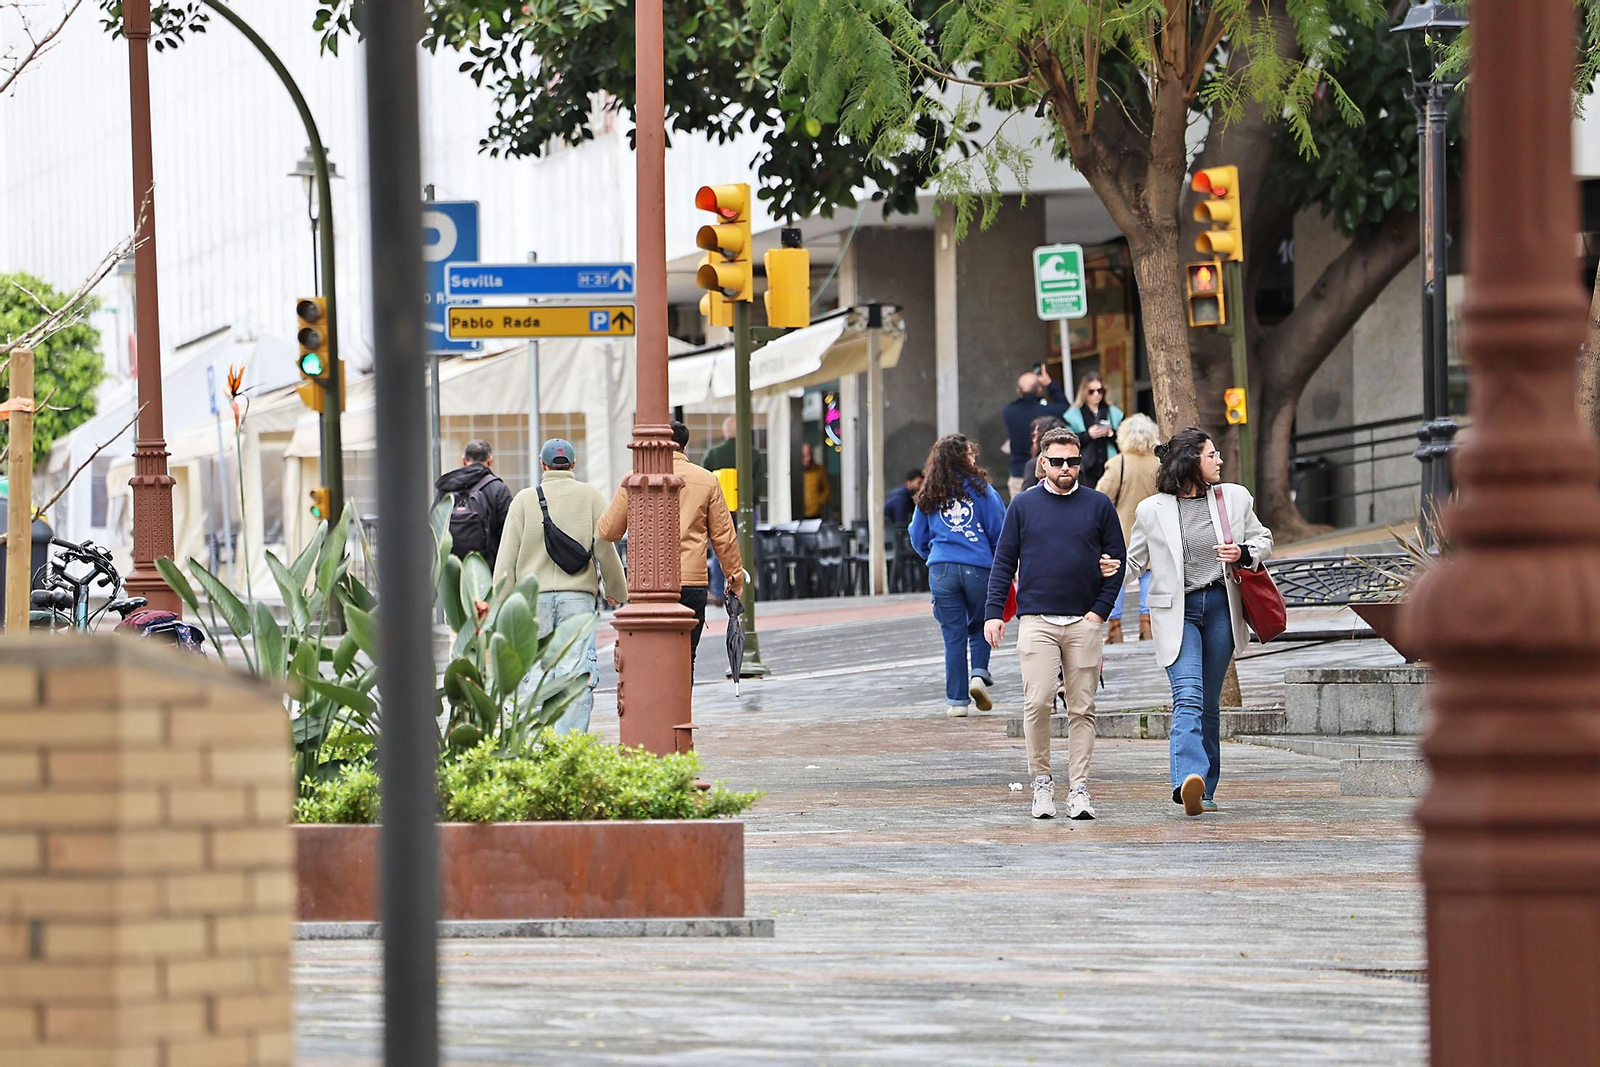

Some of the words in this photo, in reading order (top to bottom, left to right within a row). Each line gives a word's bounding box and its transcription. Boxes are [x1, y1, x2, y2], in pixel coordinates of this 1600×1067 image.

[451, 274, 503, 288] Sevilla
[581, 274, 608, 286] H-31
[452, 317, 494, 329] Pablo
[503, 315, 540, 329] Rada
[592, 312, 608, 331] P
